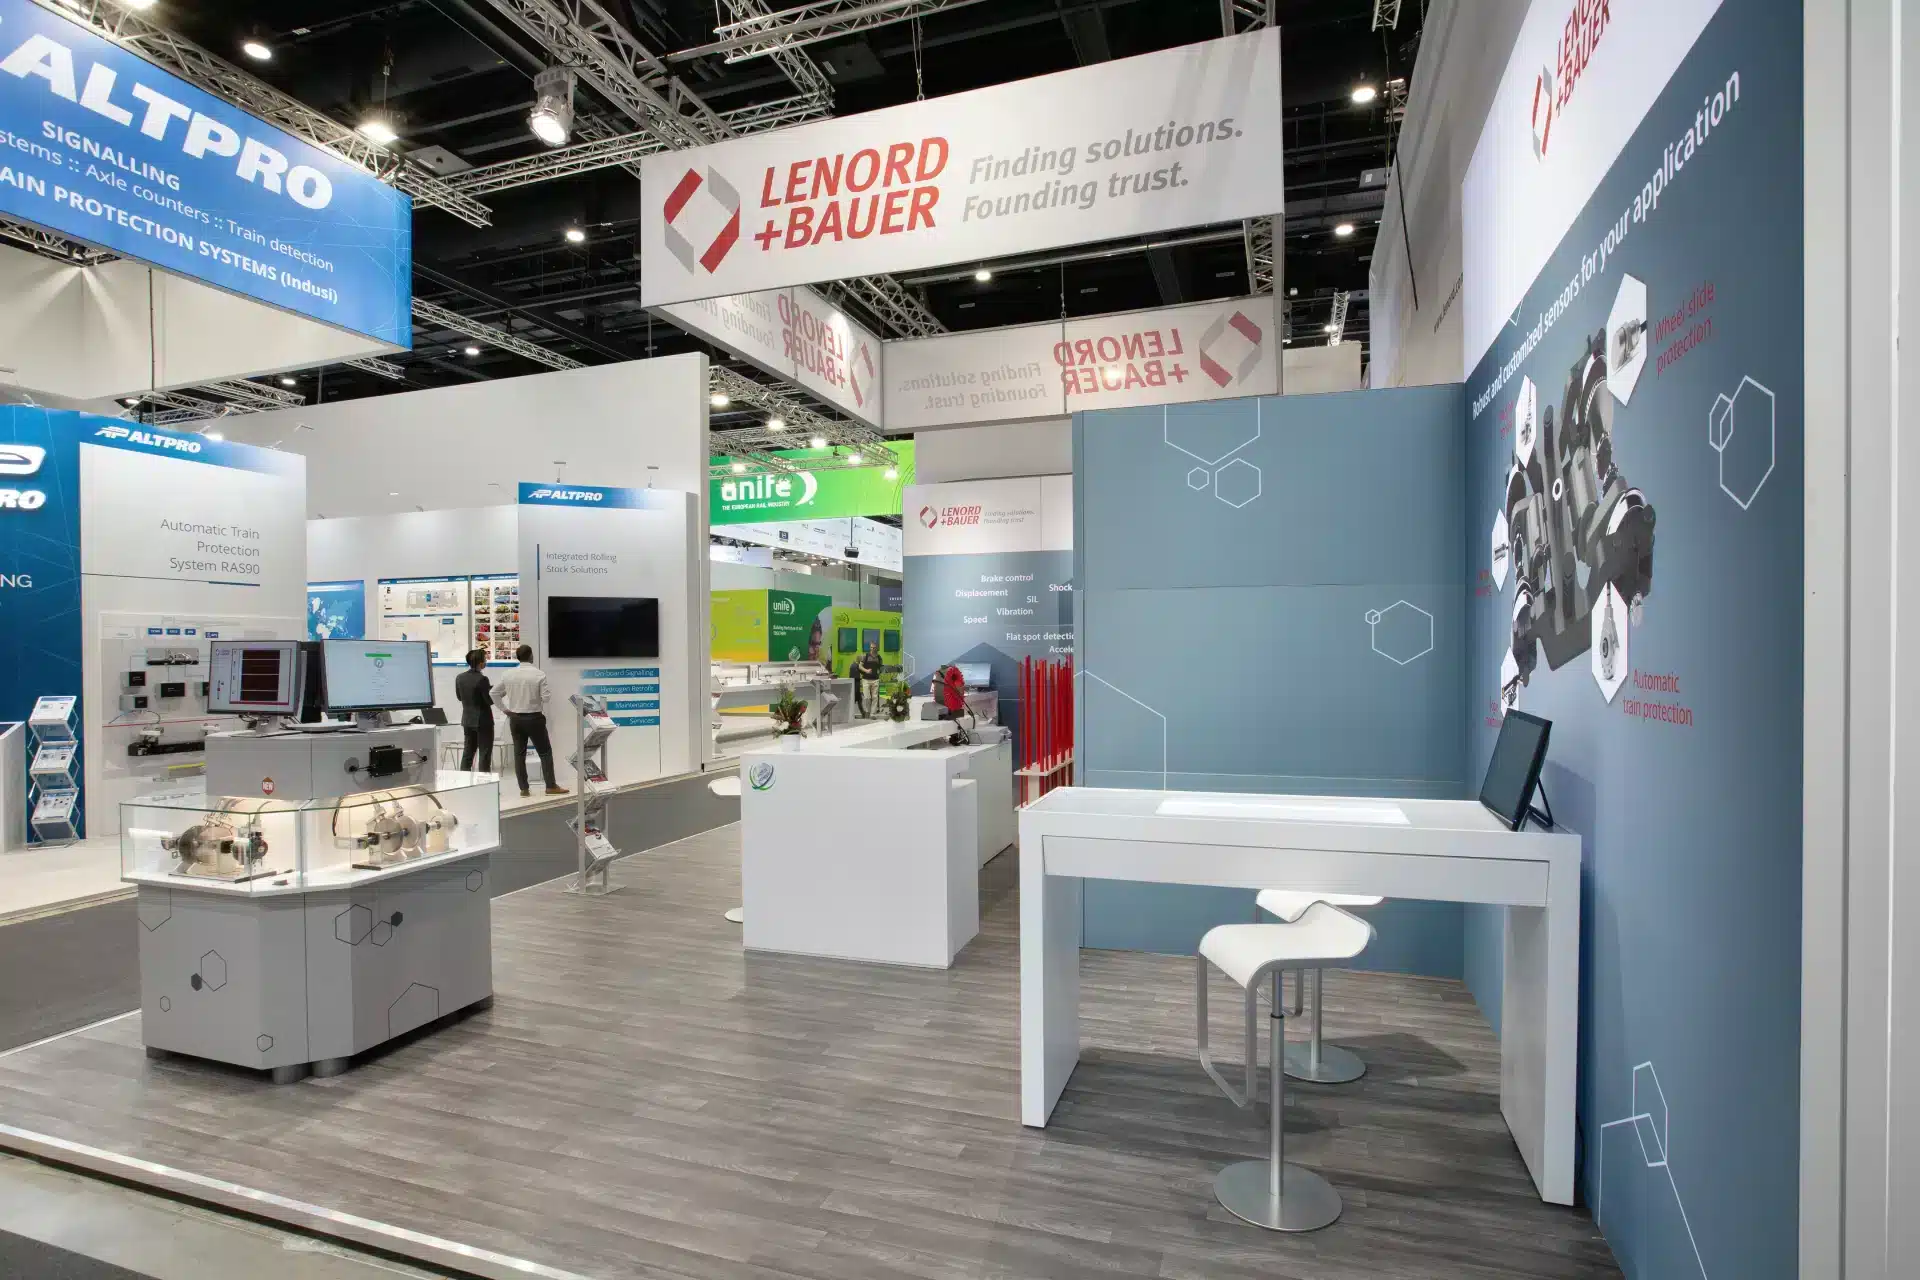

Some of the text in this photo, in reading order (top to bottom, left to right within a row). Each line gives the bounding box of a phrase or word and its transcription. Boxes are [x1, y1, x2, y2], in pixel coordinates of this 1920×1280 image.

[0, 34, 332, 210] ALTPRO
[42, 120, 181, 191] SIGNALLING
[759, 117, 1244, 208] LENORD Finding solutions.
[754, 160, 1189, 251] +BAUER Founding trust.
[86, 164, 129, 192] Axle
[133, 185, 209, 224] counters
[227, 220, 265, 246] Train
[270, 238, 334, 273] detection
[54, 185, 193, 251] PROTECTION
[200, 241, 277, 281] SYSTEMS
[280, 271, 338, 305] (Indusi)
[1473, 384, 1491, 420] Robust
[1491, 366, 1503, 398] and
[1503, 313, 1543, 383] customized
[1544, 274, 1580, 333] sensors
[1581, 249, 1598, 288] for
[1599, 208, 1630, 273] your
[1633, 70, 1740, 223] application
[1655, 280, 1716, 345] Wheel slide
[1656, 315, 1714, 380] protection
[127, 430, 201, 454] ALTPRO
[551, 490, 603, 502] ALTPRO
[941, 505, 982, 517] LENORD
[160, 519, 260, 540] Automatic Train
[941, 515, 980, 526] +BAUER
[197, 541, 260, 557] Protection
[546, 552, 618, 564] Integrated Rolling
[170, 557, 260, 575] System RAS90
[546, 565, 608, 574] Stock Solutions
[981, 574, 1034, 583] Brake control
[1049, 583, 1073, 592] Shock
[955, 588, 1008, 598] Displacement
[963, 616, 988, 625] Speed
[996, 608, 1034, 616] Vibration
[1006, 632, 1021, 641] Flat
[1023, 633, 1041, 643] spot
[1633, 668, 1681, 694] Automatic
[1623, 697, 1693, 727] train protection
[262, 781, 274, 790] NEW
